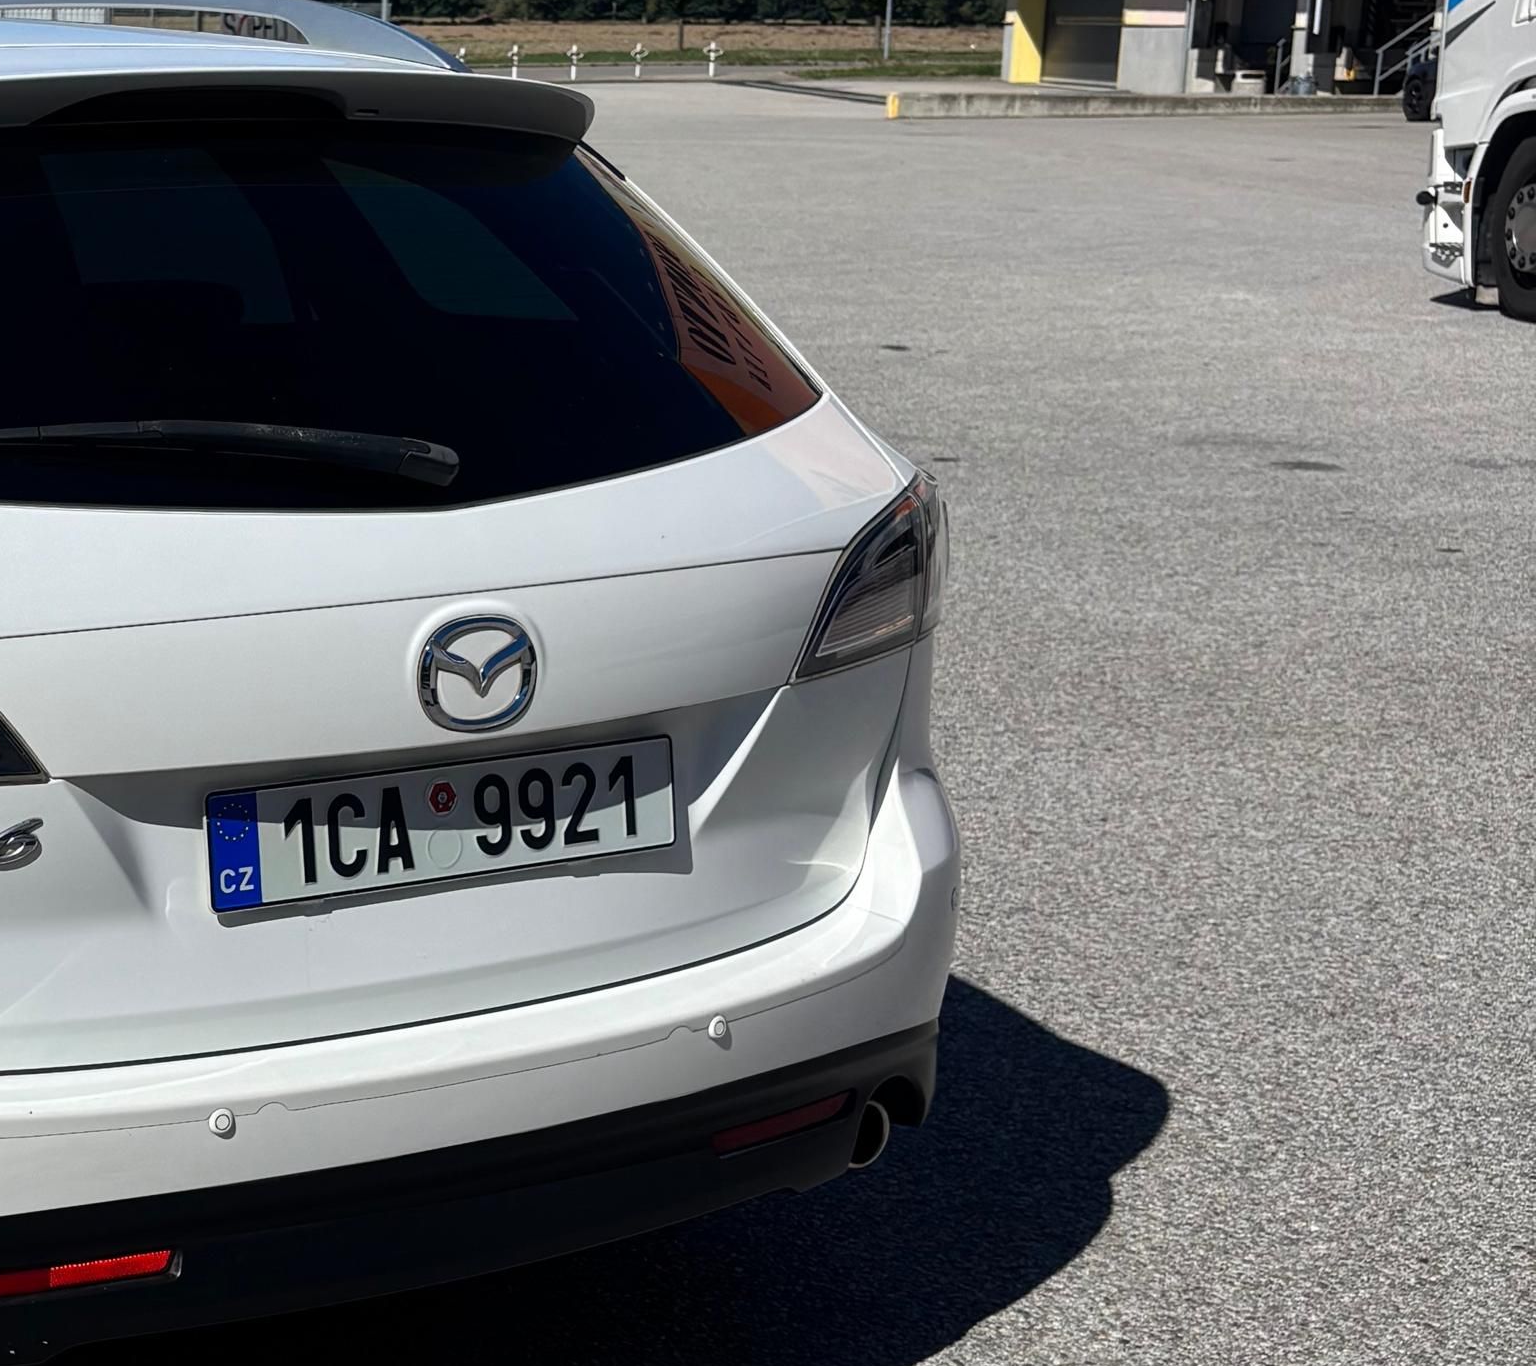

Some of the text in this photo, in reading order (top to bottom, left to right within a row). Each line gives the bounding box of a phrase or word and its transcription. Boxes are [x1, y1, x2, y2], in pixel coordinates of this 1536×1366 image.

[282, 755, 638, 886] 1CA 9921
[219, 866, 255, 895] CZ
